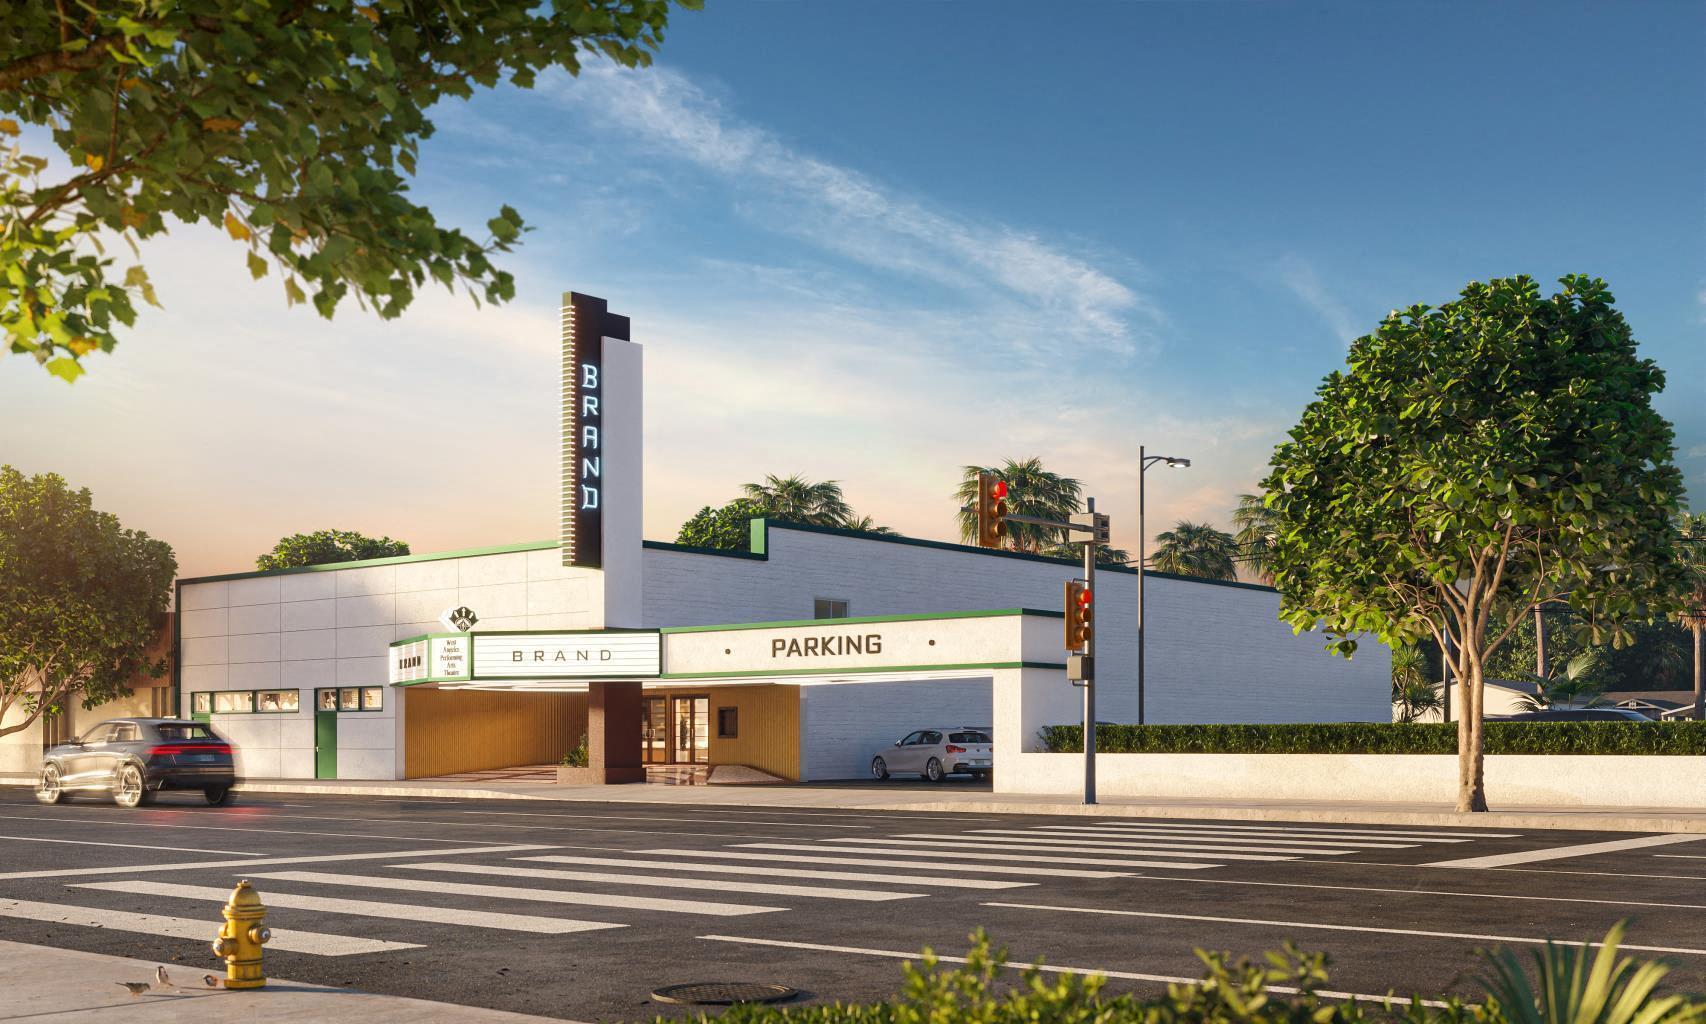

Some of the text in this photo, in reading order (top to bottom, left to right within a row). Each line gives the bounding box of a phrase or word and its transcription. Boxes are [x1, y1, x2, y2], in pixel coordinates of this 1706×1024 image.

[581, 364, 599, 509] BRAND
[512, 650, 612, 662] BRAND
[771, 634, 882, 657] PARKING
